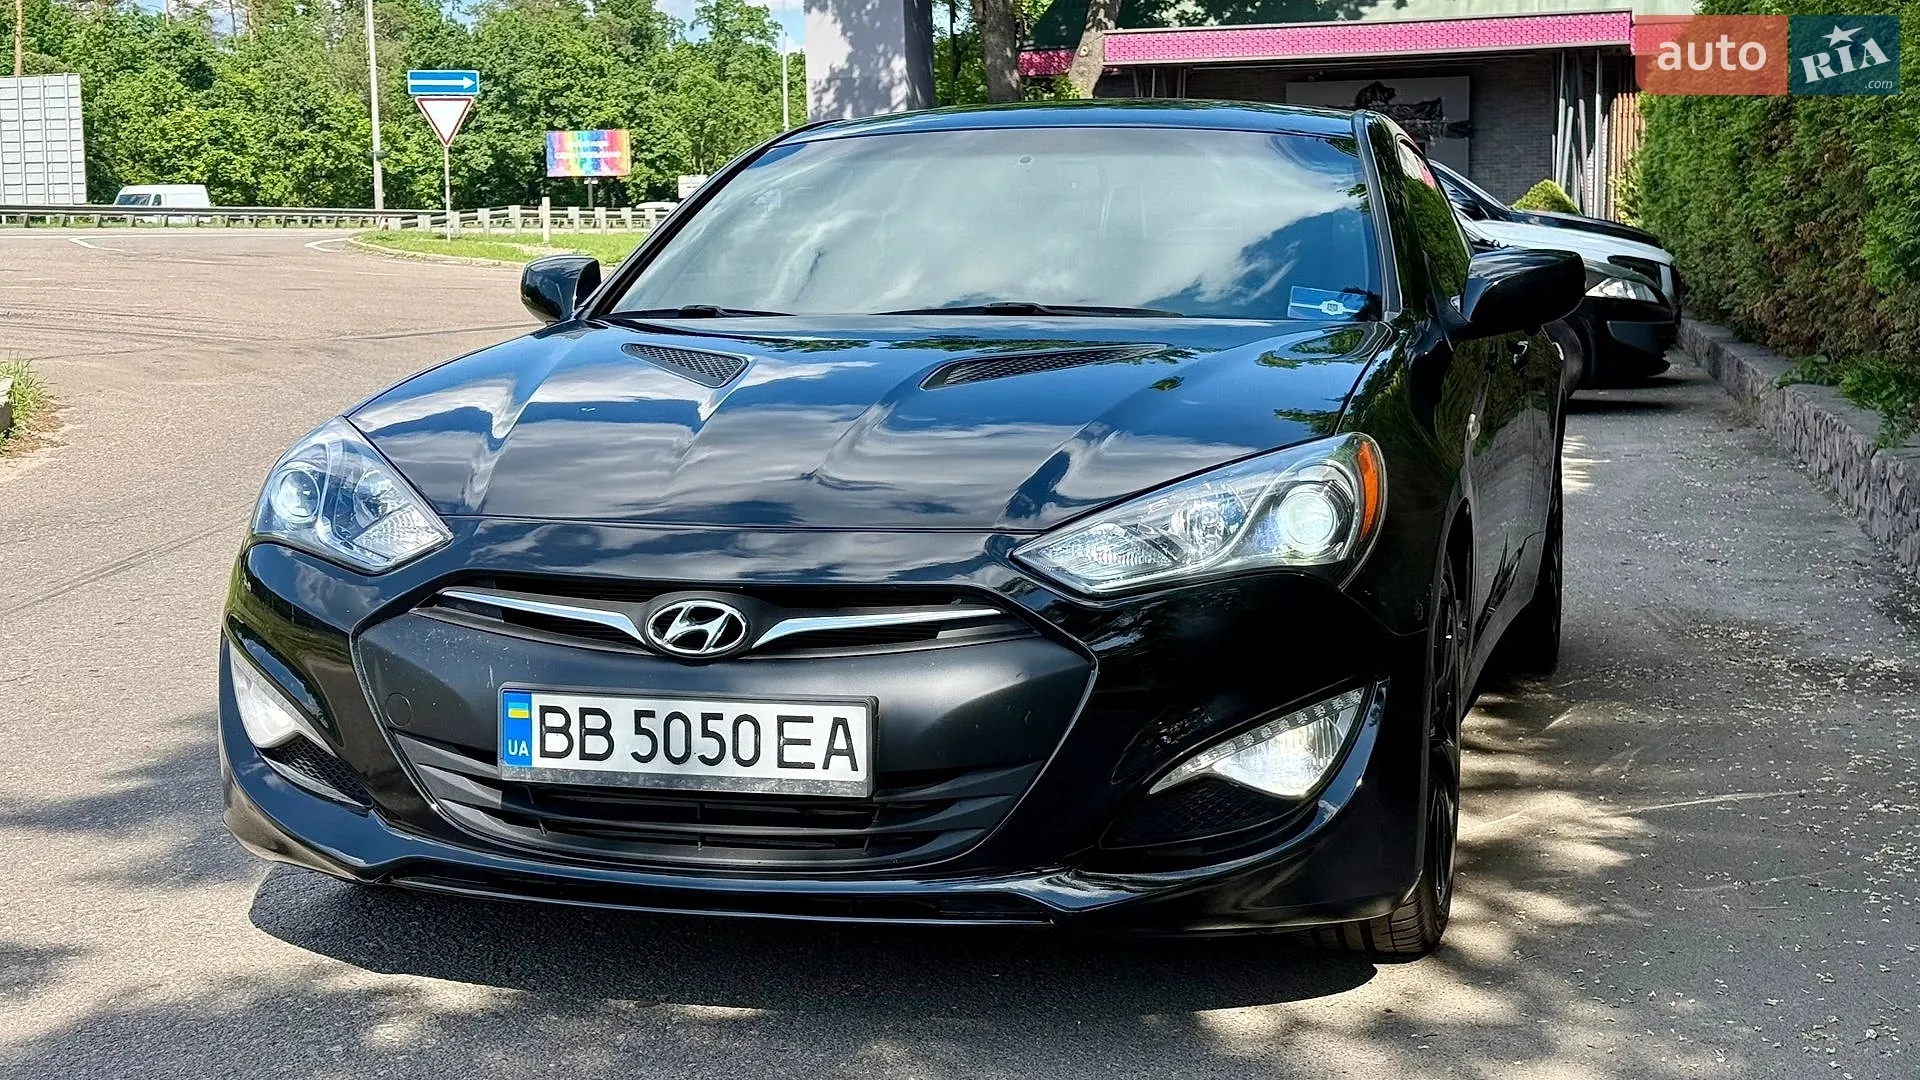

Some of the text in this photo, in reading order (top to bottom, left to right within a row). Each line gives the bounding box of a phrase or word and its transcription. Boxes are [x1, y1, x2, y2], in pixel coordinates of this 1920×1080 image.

[508, 739, 530, 757] UA
[539, 704, 859, 772] BB 5050 EA
